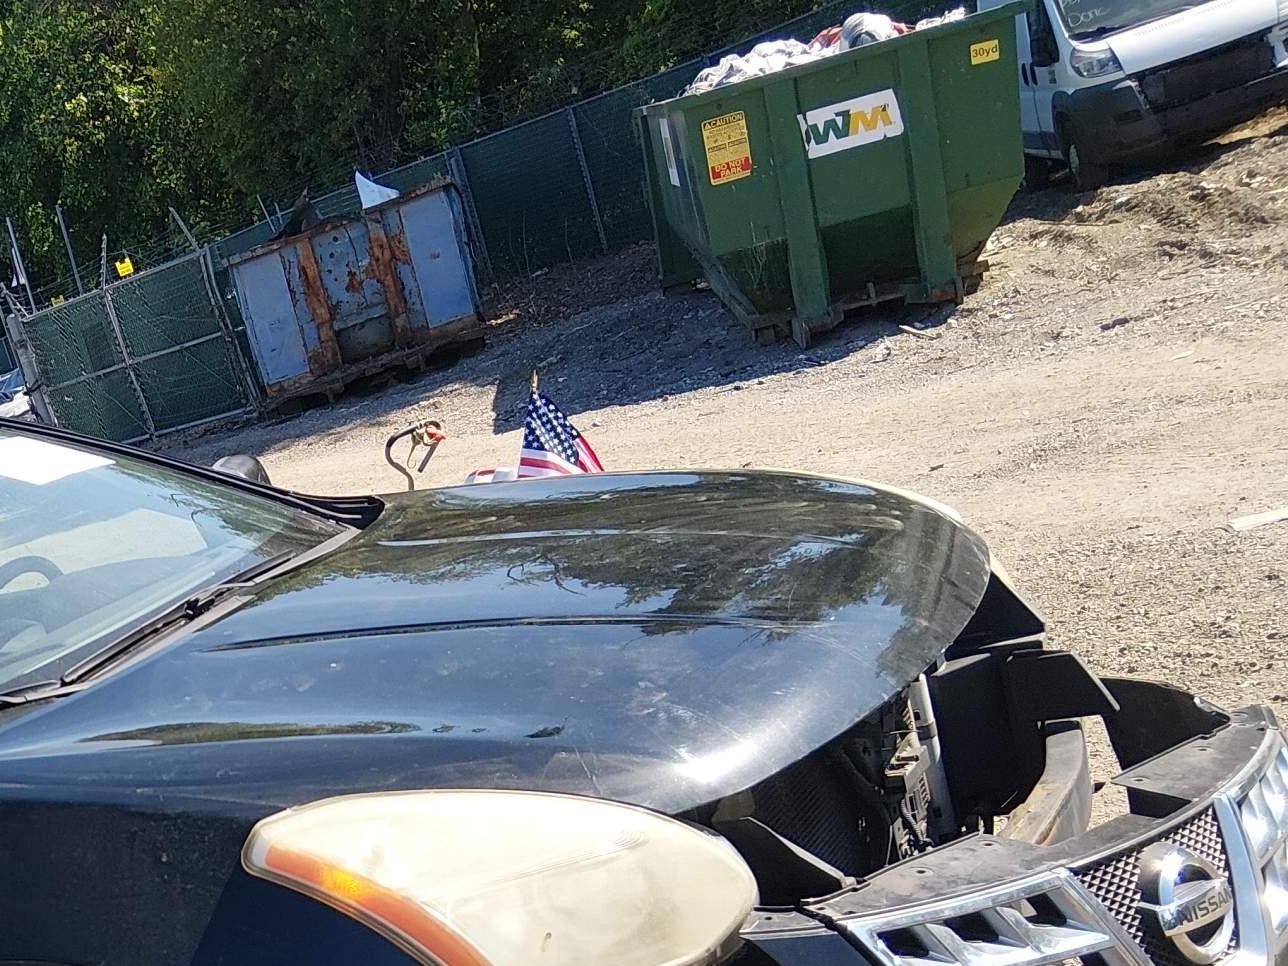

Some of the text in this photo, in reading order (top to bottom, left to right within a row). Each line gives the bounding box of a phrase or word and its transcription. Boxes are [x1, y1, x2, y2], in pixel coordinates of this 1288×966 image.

[972, 44, 998, 58] 30yd
[710, 113, 743, 128] CAUTION
[807, 103, 894, 146] WM
[715, 159, 746, 173] DO NOT
[720, 167, 743, 178] PARK
[1176, 887, 1232, 926] NISSAN
